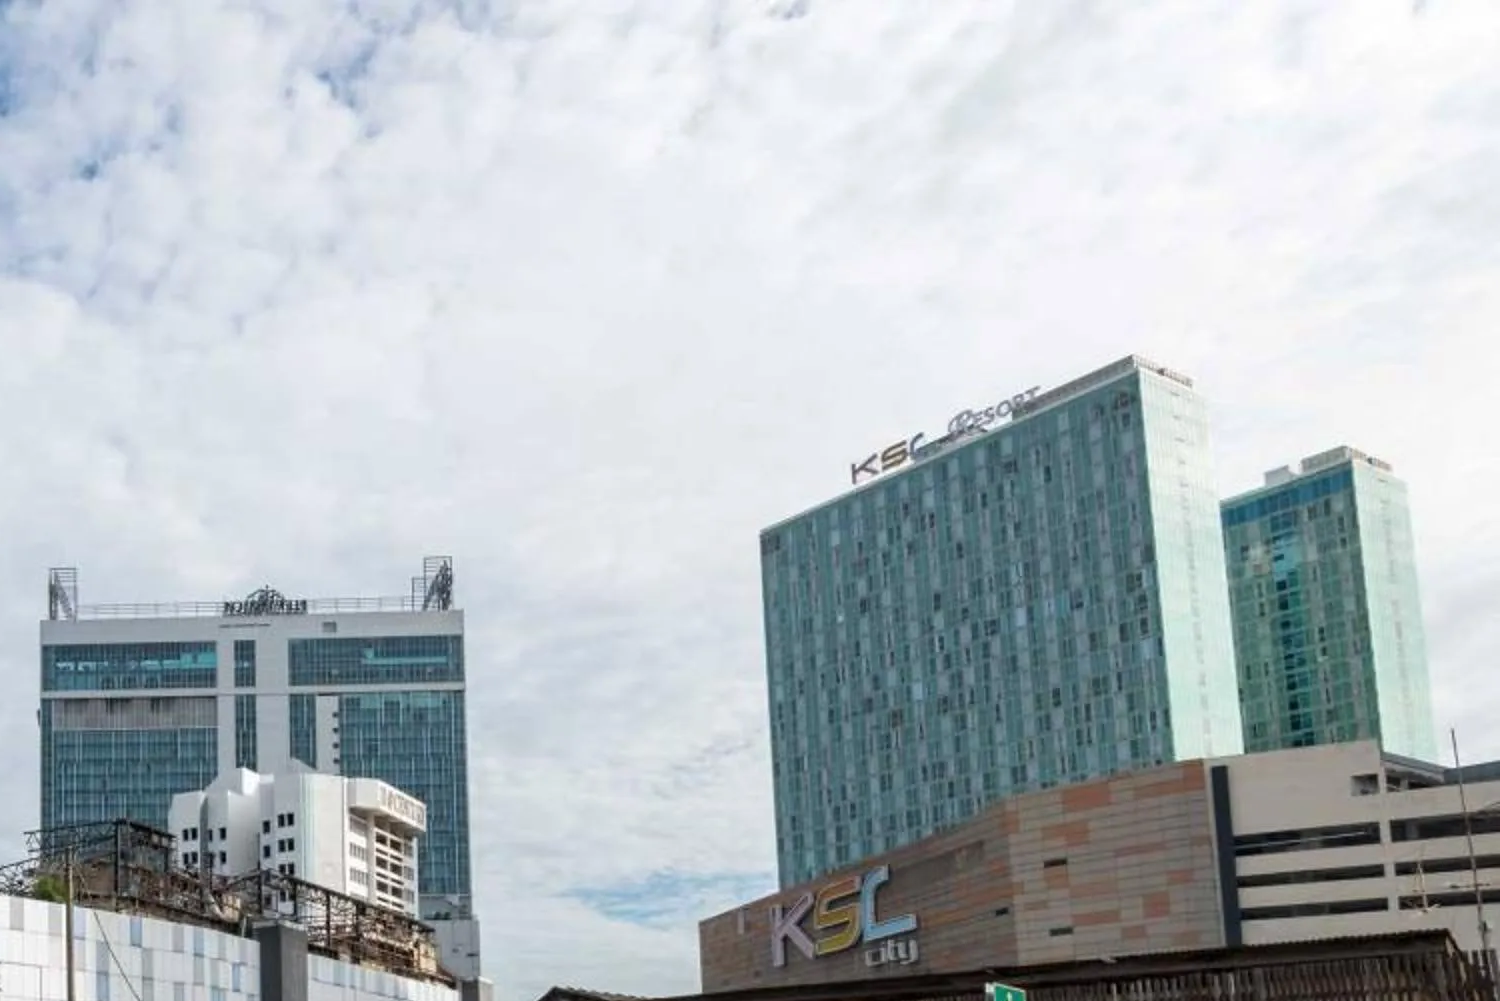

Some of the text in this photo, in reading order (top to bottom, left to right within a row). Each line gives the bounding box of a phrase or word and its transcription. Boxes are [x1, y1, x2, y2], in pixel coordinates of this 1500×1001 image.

[851, 432, 926, 484] KSL
[769, 863, 918, 968] KSL
[864, 938, 919, 967] city
